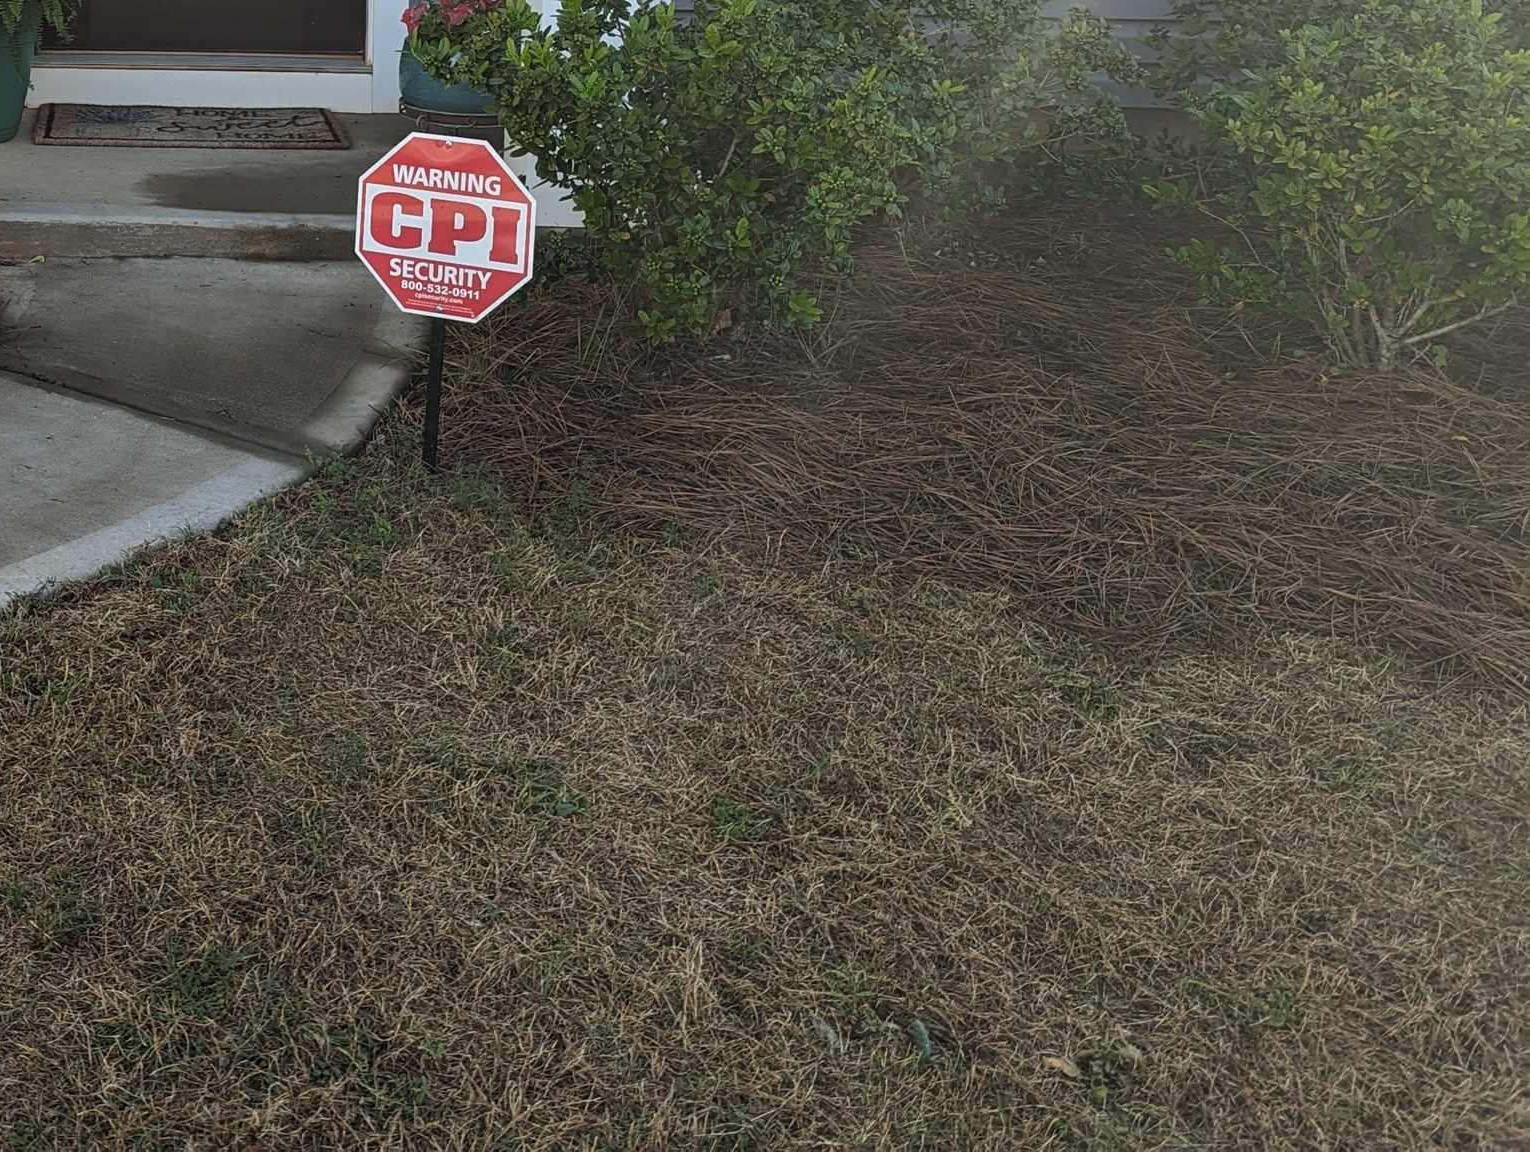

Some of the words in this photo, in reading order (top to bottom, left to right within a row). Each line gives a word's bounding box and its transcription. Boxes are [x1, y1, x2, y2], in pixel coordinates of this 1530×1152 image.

[392, 163, 502, 196] WARNING
[370, 191, 521, 265] CPI
[389, 257, 493, 290] SECURITY
[401, 280, 480, 300] 800-532-0911
